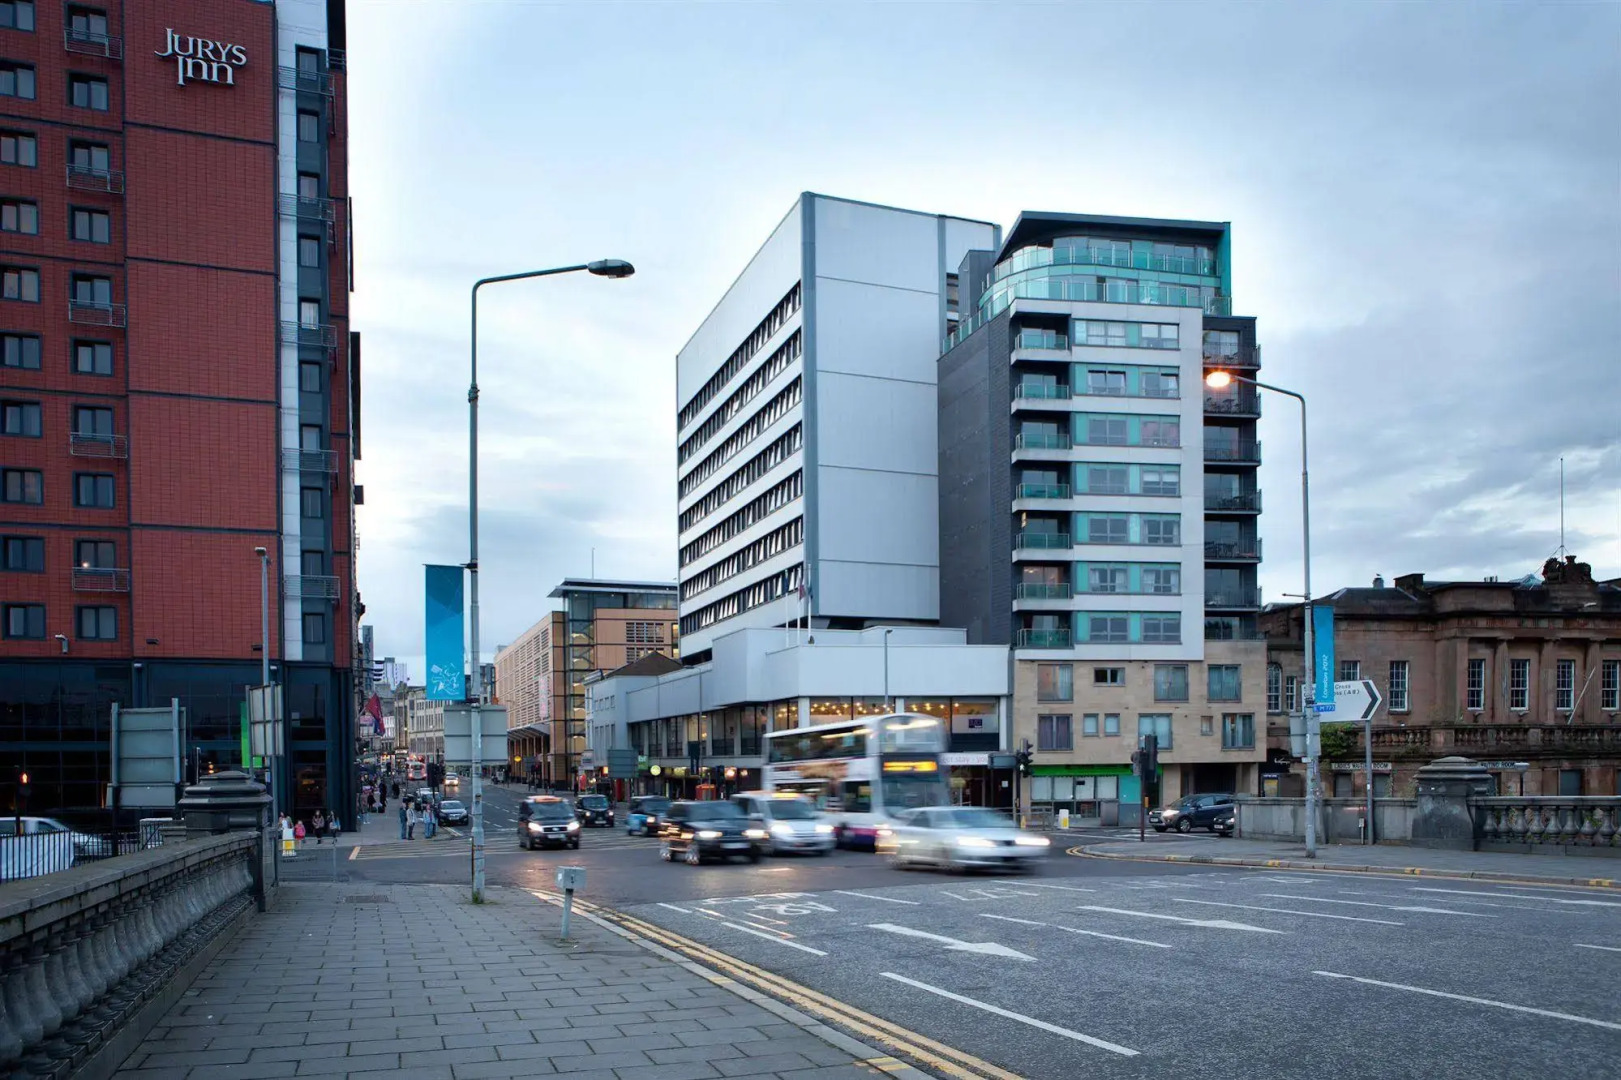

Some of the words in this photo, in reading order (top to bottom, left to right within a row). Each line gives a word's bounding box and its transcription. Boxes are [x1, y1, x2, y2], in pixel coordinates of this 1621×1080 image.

[154, 27, 247, 66] JURYS
[177, 55, 235, 86] Inn
[1321, 654, 1329, 671] 2012
[1321, 671, 1329, 699] London
[1334, 683, 1352, 691] Cross
